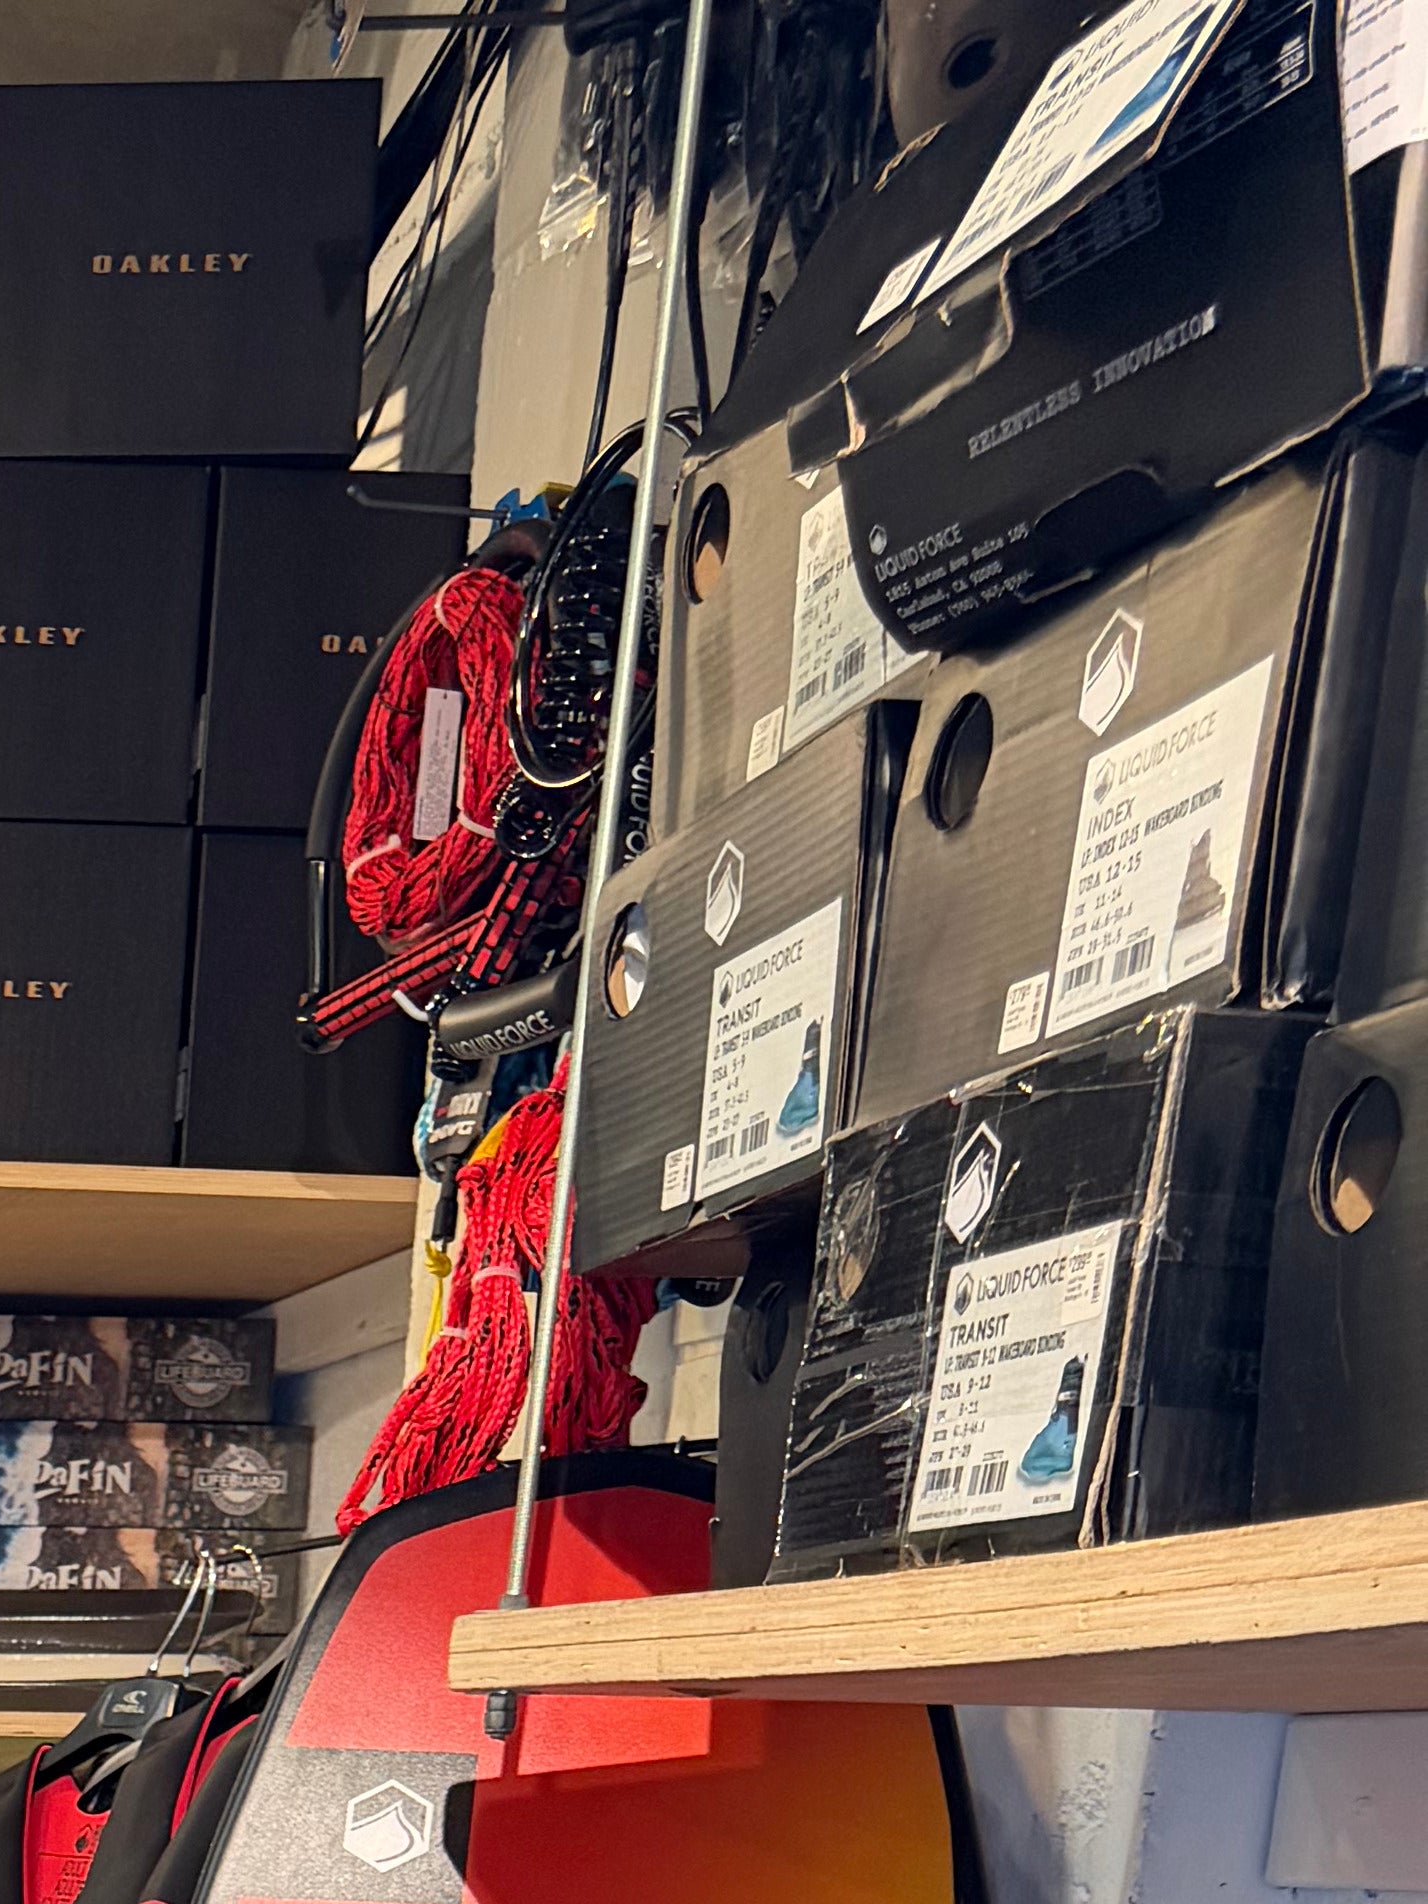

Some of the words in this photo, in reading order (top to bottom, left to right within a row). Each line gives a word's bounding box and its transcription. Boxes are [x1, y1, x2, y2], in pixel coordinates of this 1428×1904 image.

[1026, 40, 1124, 125] TRANSIT
[92, 253, 249, 274] OAKLEY
[968, 378, 1082, 459] RELENTLESS
[1093, 304, 1218, 394] INNOVATION
[1086, 795, 1135, 842] INDEX
[1076, 869, 1102, 899] USA
[1105, 848, 1142, 885] 12-15
[497, 1010, 555, 1047] FORCE
[715, 997, 761, 1038] TRANSIT
[1021, 1254, 1068, 1291] FORCE
[947, 1312, 1010, 1348] TRANSIT
